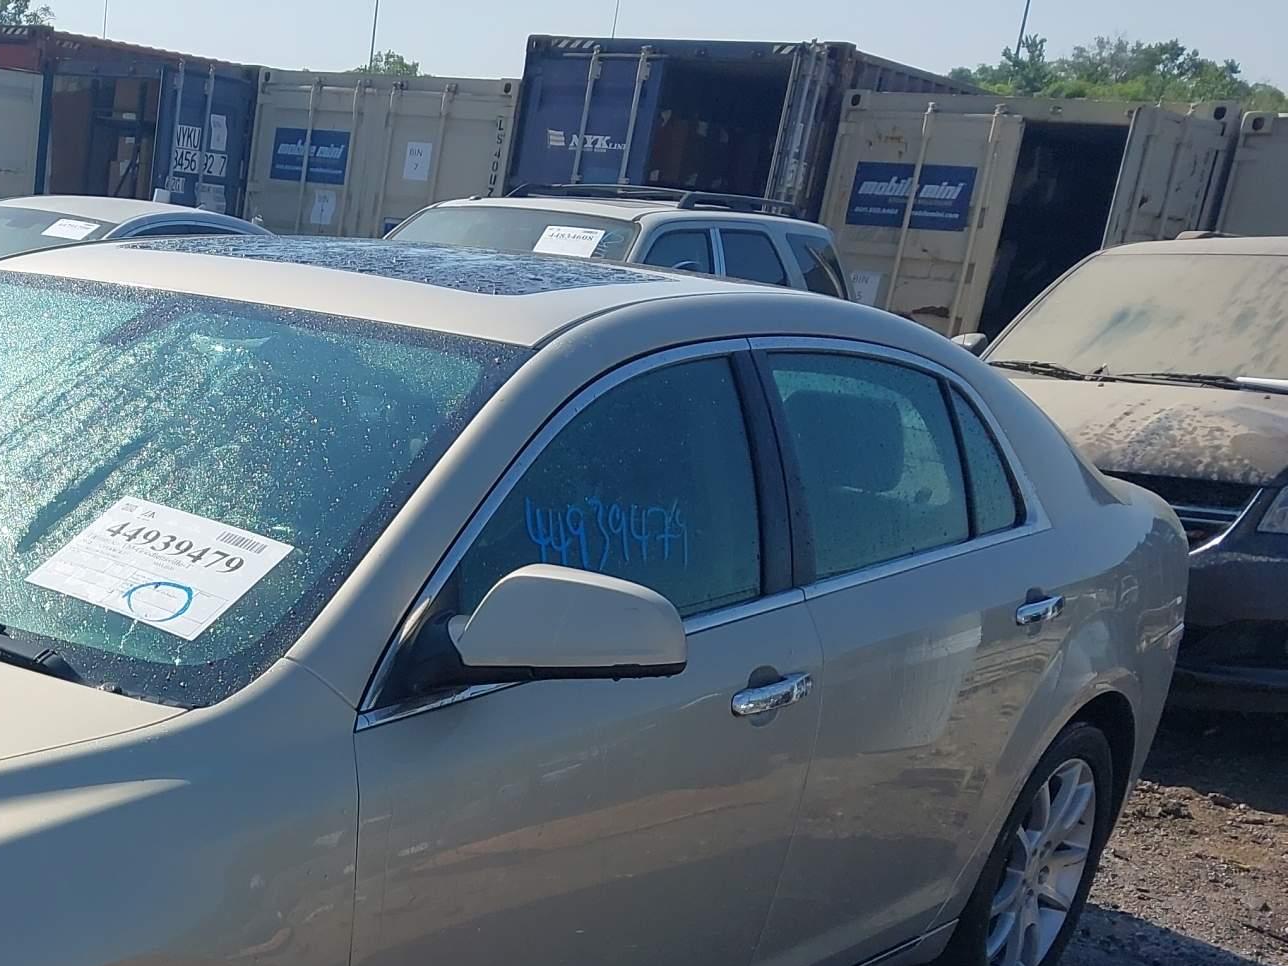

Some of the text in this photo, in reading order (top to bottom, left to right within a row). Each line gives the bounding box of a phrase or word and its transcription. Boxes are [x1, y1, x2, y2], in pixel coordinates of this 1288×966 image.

[409, 148, 423, 158] BIN
[858, 176, 967, 200] mobil mini
[106, 521, 245, 573] 44939479
